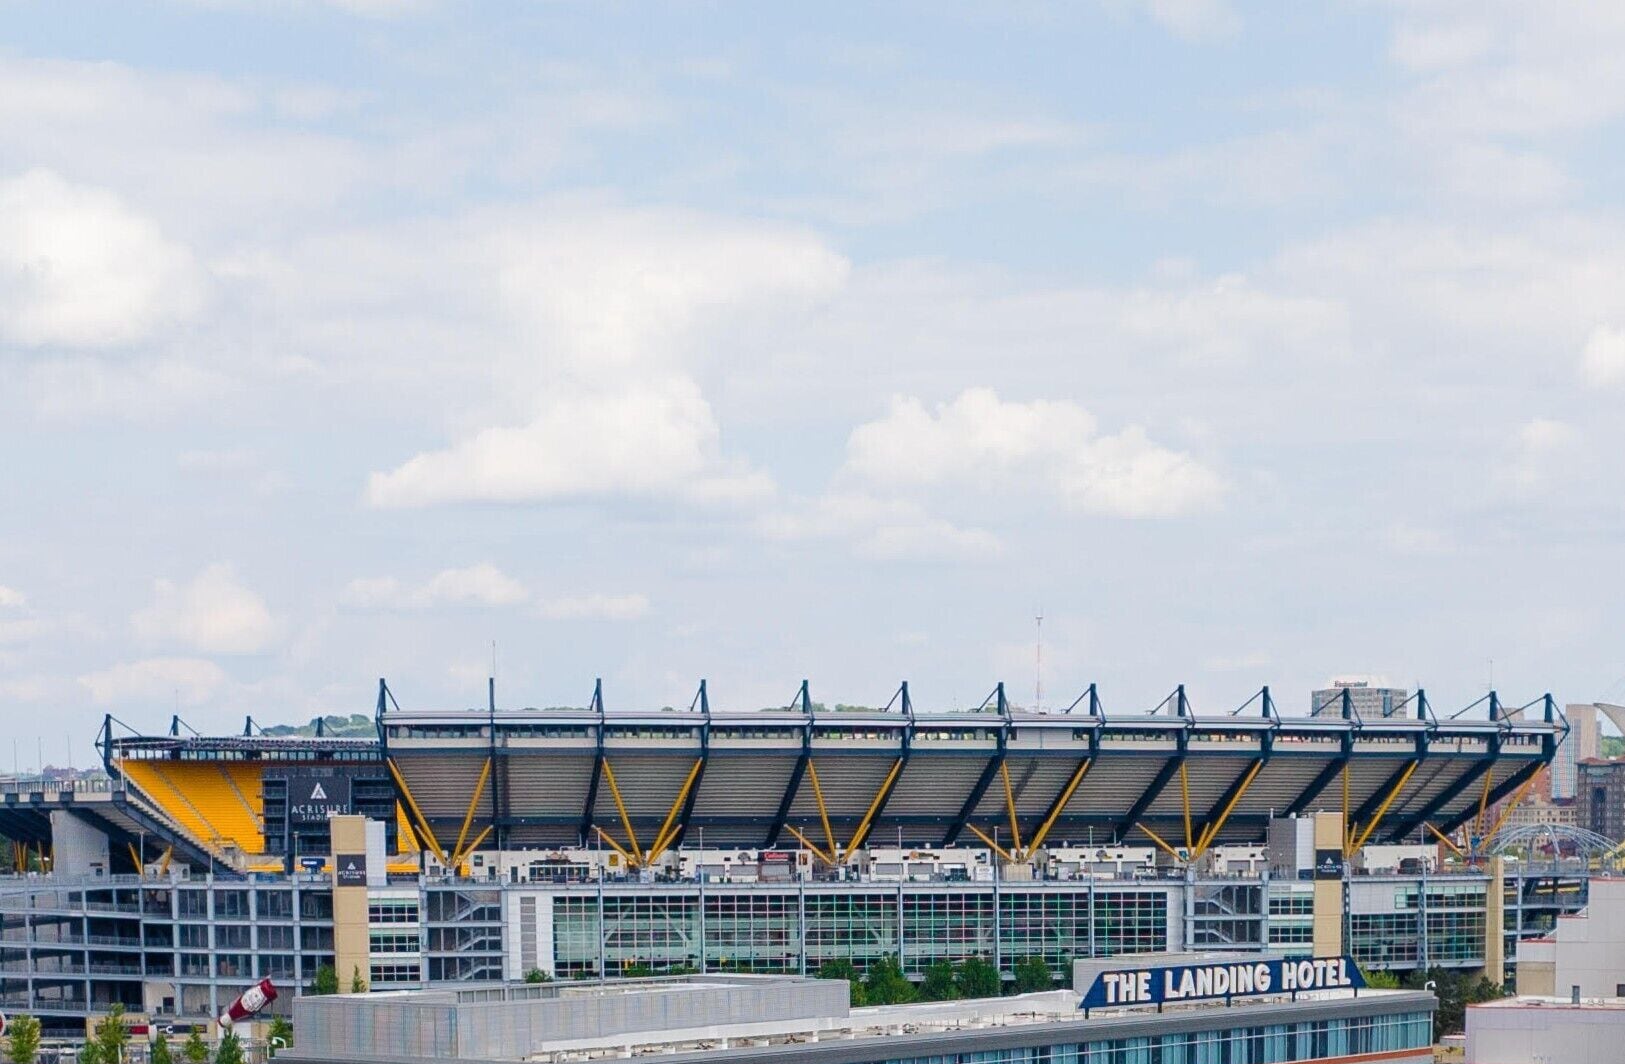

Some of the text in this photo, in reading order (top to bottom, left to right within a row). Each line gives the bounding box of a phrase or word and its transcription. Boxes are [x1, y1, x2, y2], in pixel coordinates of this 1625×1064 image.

[291, 803, 348, 814] ACRISURE
[1103, 957, 1352, 1003] THE LANDING HOTEL
